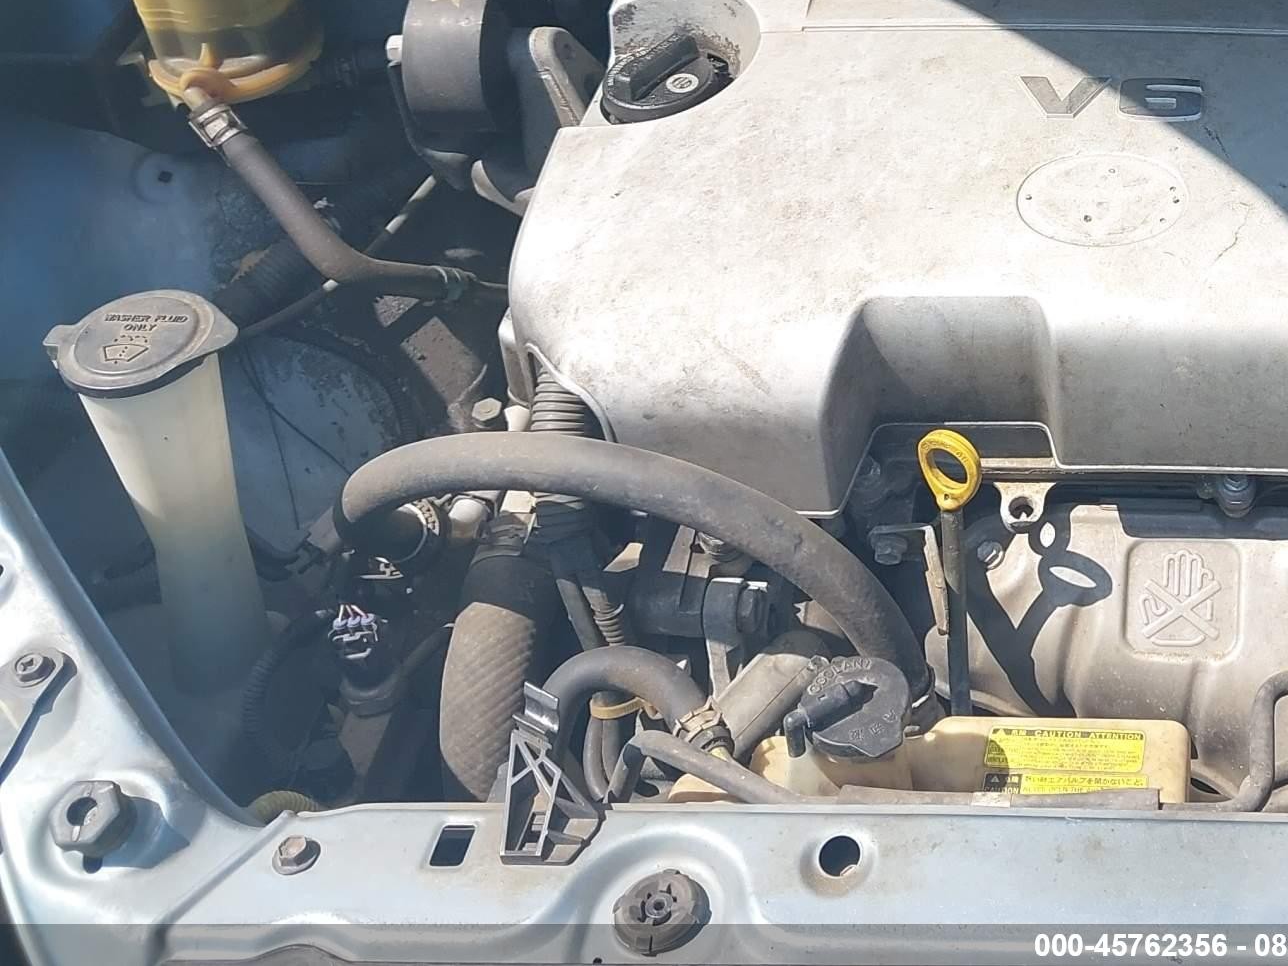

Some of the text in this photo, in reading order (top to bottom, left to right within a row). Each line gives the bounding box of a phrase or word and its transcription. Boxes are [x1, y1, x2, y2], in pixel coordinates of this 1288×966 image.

[1017, 75, 1205, 123] V6
[104, 313, 189, 323] WASHER FLUID
[123, 323, 158, 331] ONLY
[807, 658, 873, 695] COOLANT
[1034, 730, 1082, 738] CAUTION
[1090, 732, 1142, 741] ATTENTION
